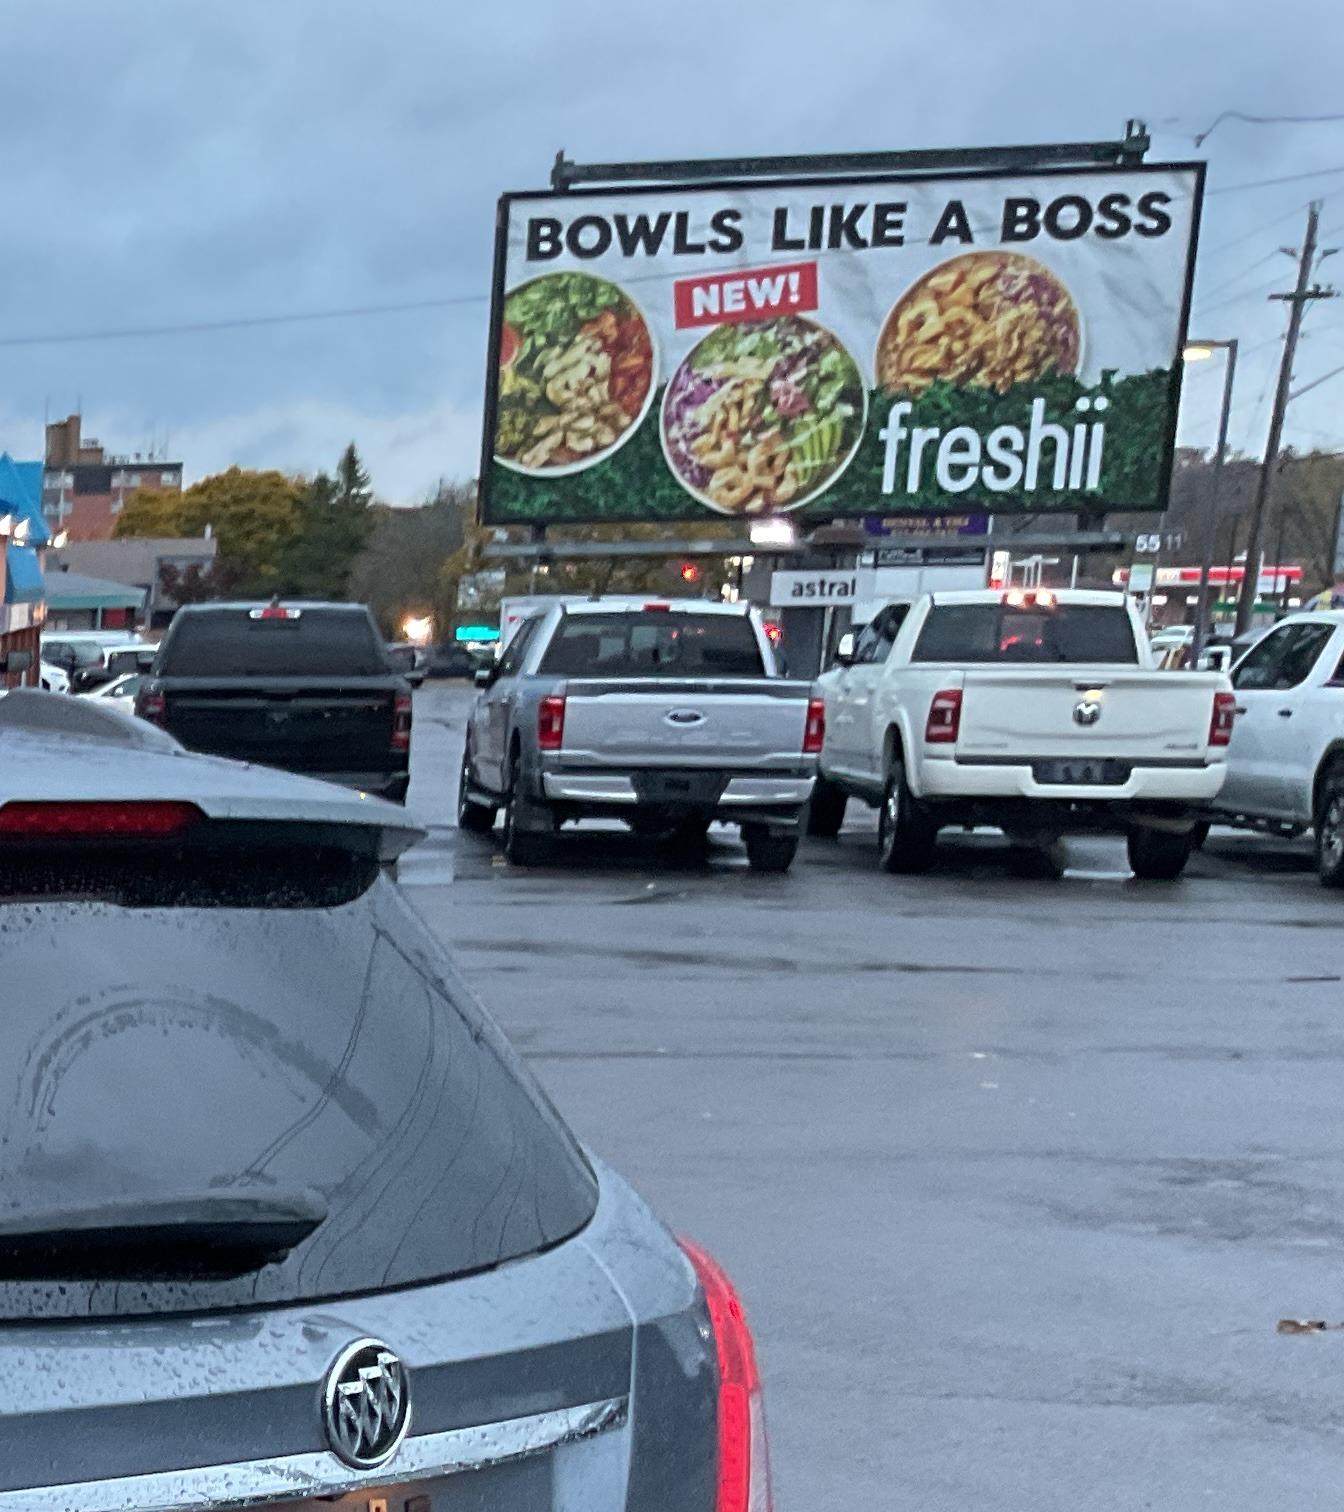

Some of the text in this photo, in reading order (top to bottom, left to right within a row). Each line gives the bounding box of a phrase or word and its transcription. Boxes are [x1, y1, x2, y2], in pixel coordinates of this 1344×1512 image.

[526, 191, 1173, 262] BOWLS LIKE A BOSS
[693, 271, 800, 318] NEW!
[878, 395, 1109, 495] freshii
[791, 574, 857, 598] astral
